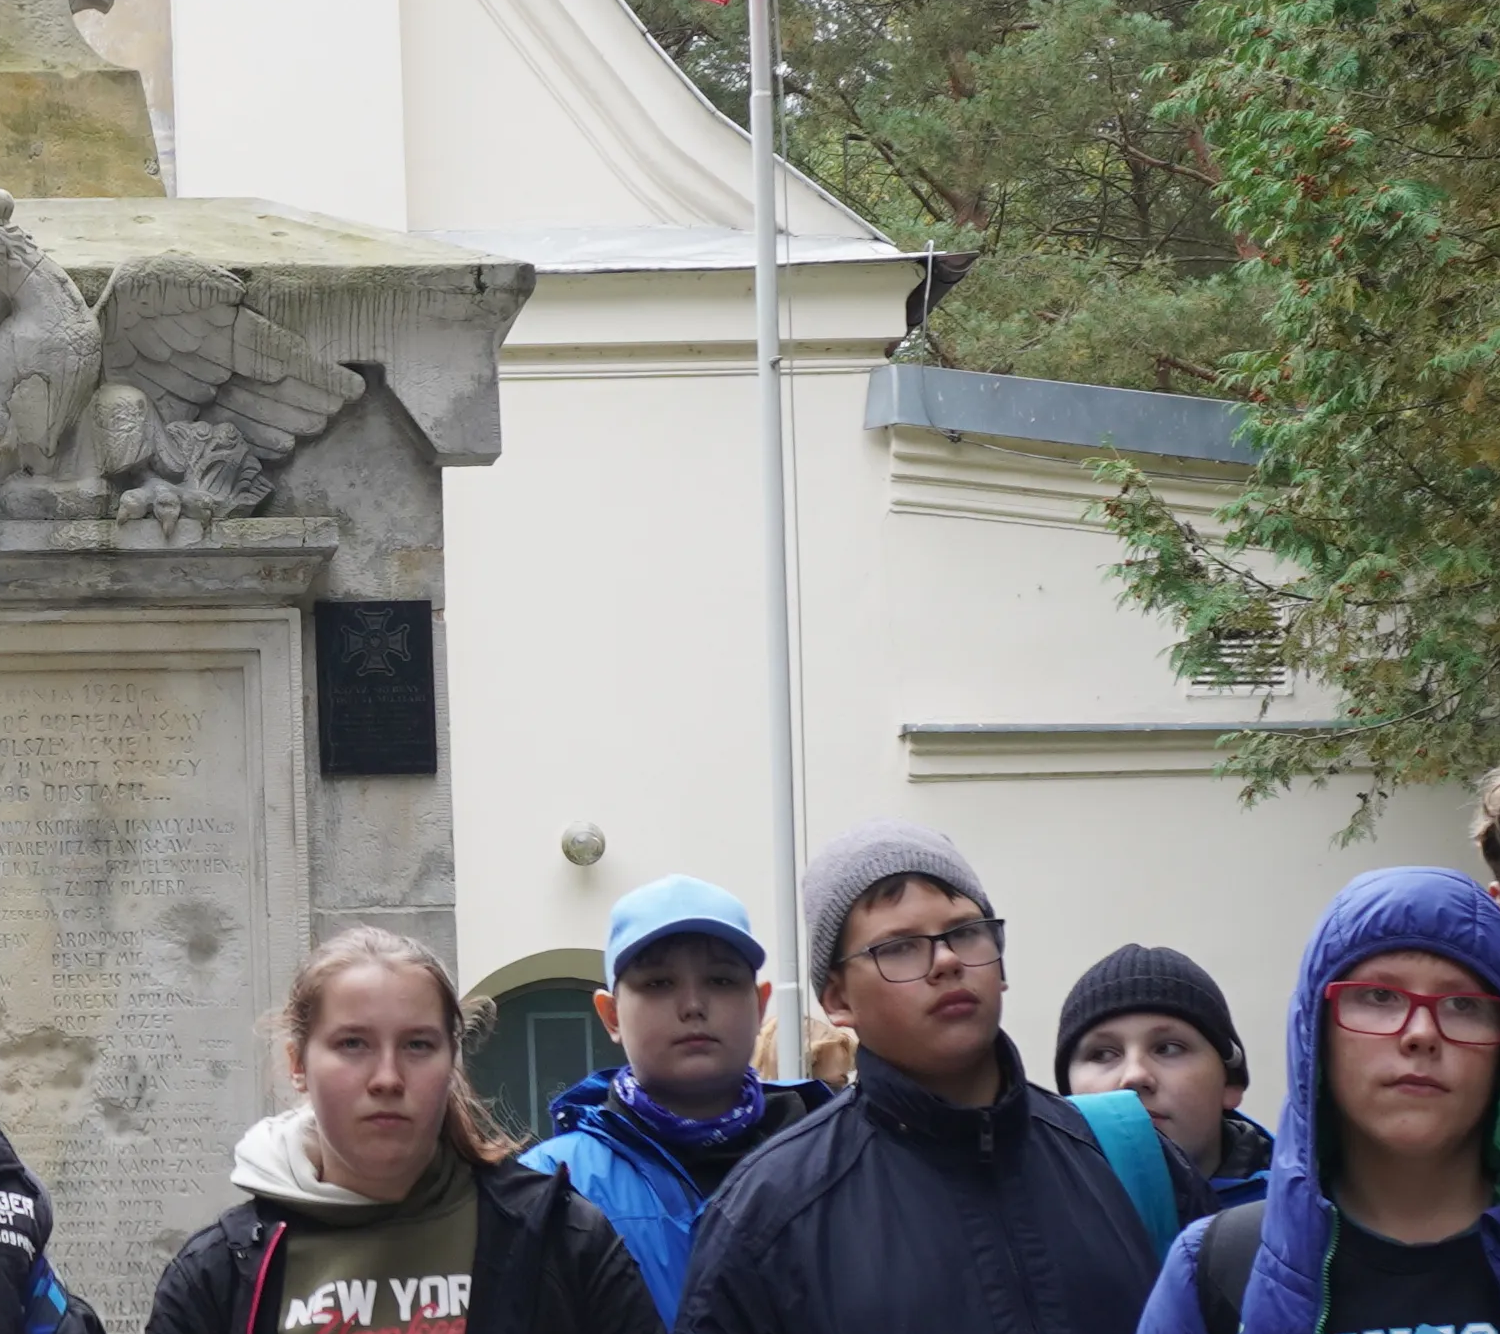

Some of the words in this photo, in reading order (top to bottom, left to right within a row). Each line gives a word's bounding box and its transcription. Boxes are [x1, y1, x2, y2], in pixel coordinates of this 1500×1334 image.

[82, 680, 136, 708] 1920
[285, 1279, 377, 1330] NEW
[389, 1274, 472, 1322] YOR
